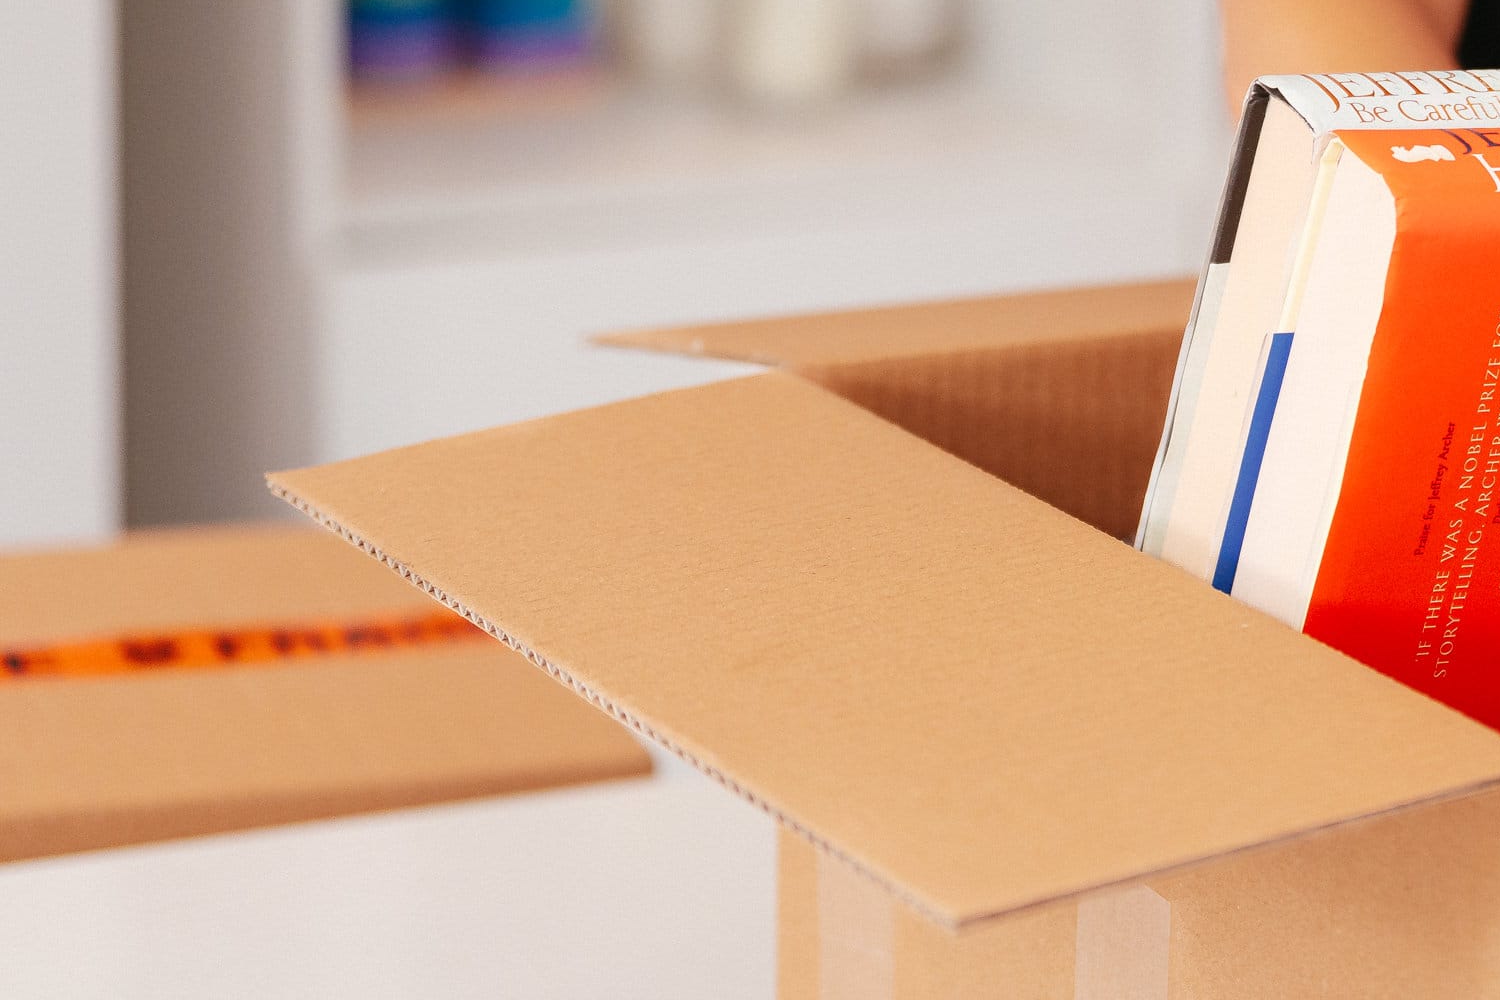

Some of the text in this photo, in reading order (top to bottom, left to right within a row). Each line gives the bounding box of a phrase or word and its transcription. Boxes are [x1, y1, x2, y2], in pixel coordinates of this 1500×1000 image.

[1349, 102, 1393, 123] Be
[1458, 421, 1487, 489] NOBEL
[1414, 421, 1454, 556] Praise for Jeffrey Archer
[1453, 497, 1469, 511] A
[1439, 518, 1463, 563] WAS
[1422, 570, 1450, 633] THERE
